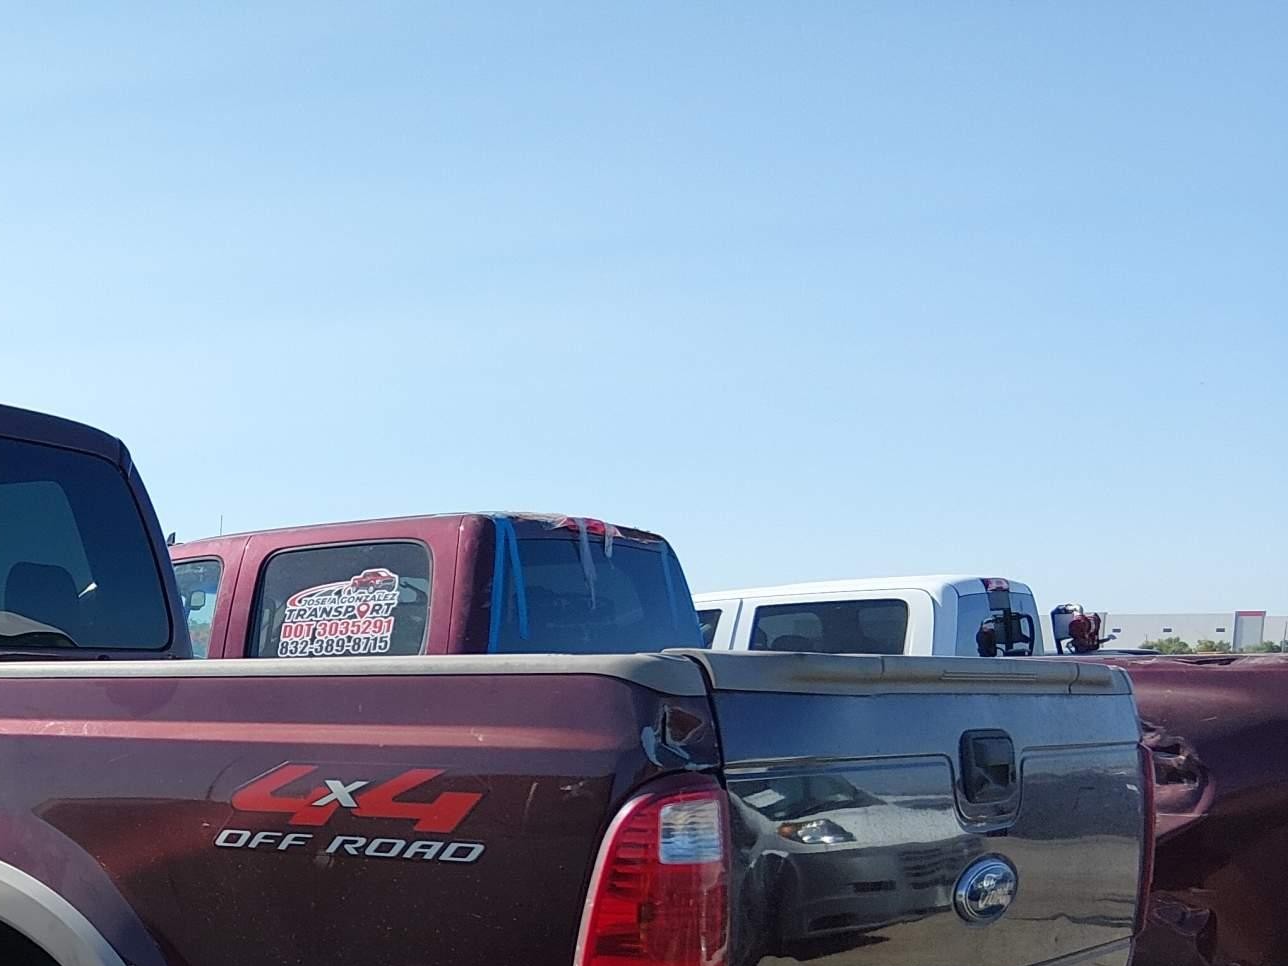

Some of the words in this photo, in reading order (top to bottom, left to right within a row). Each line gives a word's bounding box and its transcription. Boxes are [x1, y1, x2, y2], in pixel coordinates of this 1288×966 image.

[340, 592, 398, 605] GONZALEZ
[285, 601, 396, 621] TRANSPORT
[282, 623, 314, 640] DOT
[316, 618, 393, 637] 3035291
[279, 636, 389, 656] 832-389-8715
[215, 829, 313, 850] OFF
[325, 836, 486, 863] ROAD
